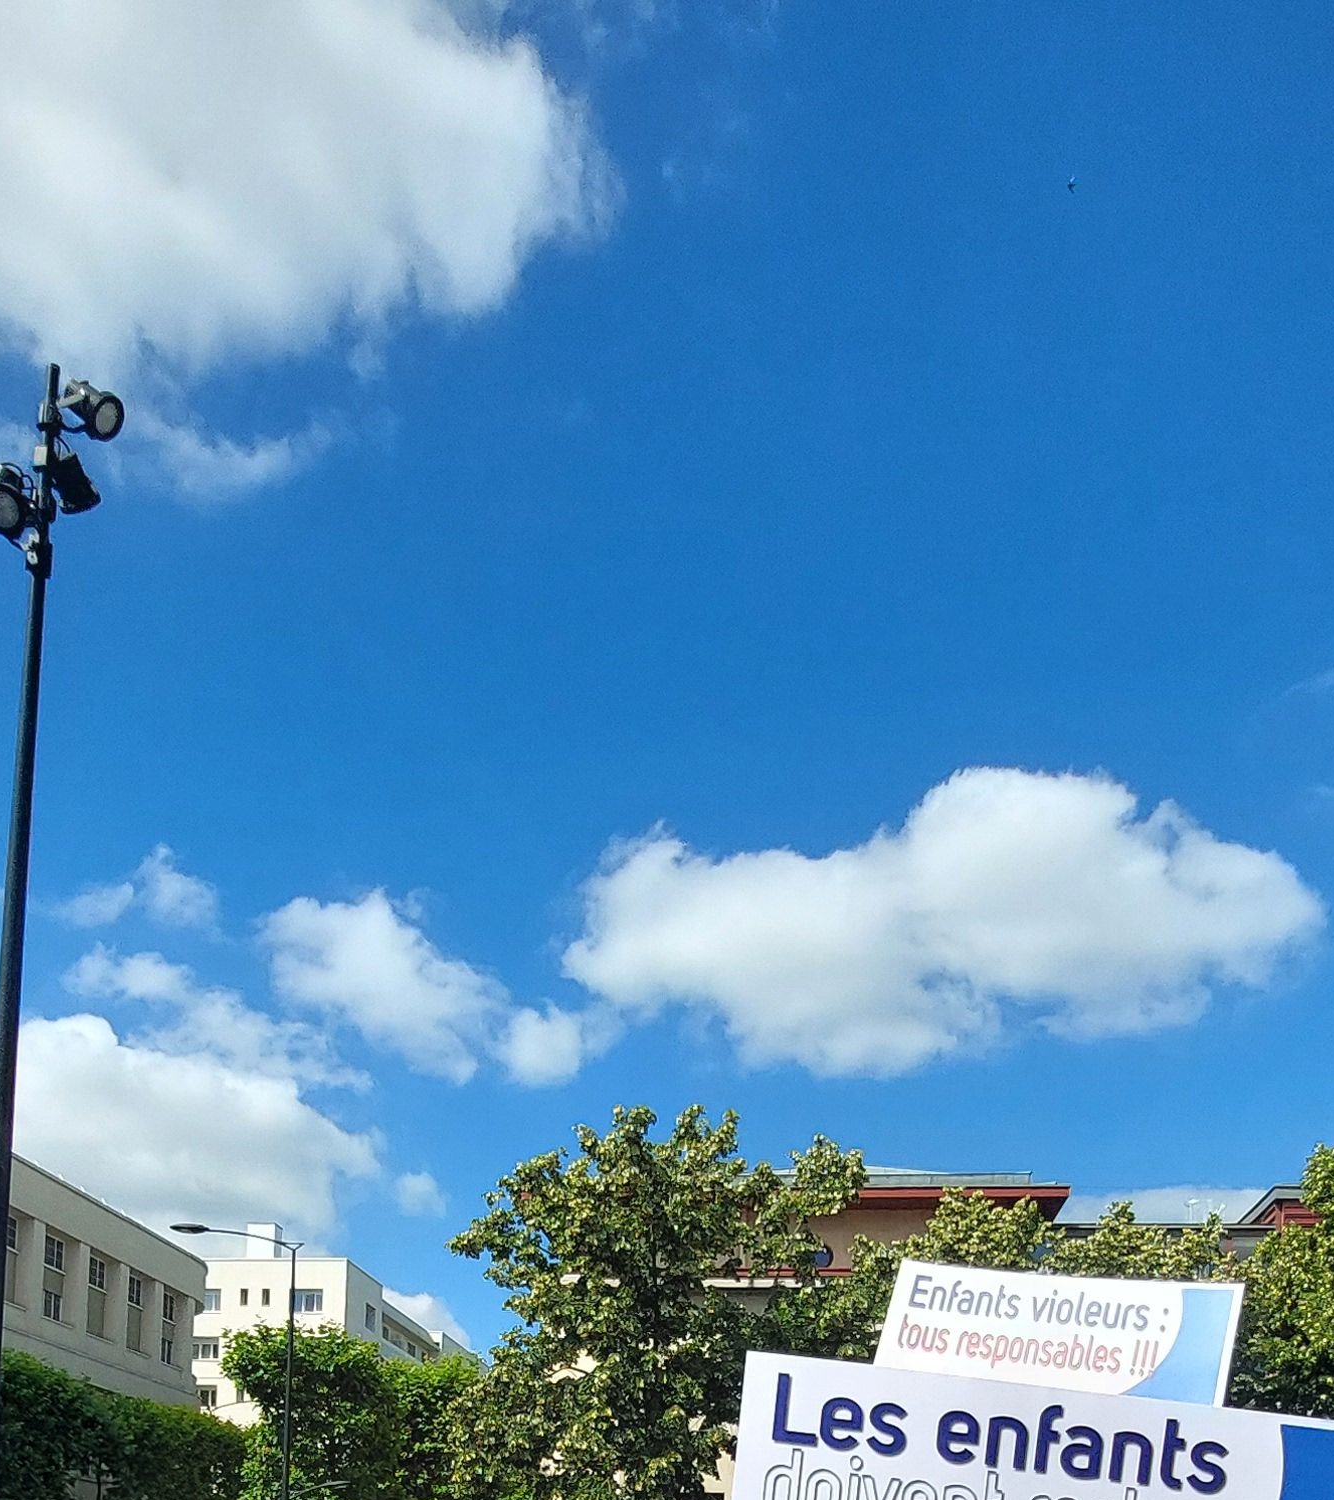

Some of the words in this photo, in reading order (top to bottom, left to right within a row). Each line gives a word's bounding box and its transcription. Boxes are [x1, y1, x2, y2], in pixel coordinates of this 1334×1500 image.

[908, 1273, 1021, 1321] Enfants
[1031, 1288, 1151, 1333] violeurs
[897, 1313, 952, 1355] tous
[955, 1328, 1124, 1375] responsables
[1128, 1338, 1160, 1379] !!!
[771, 1372, 908, 1458] Les
[936, 1403, 1231, 1495] enfants
